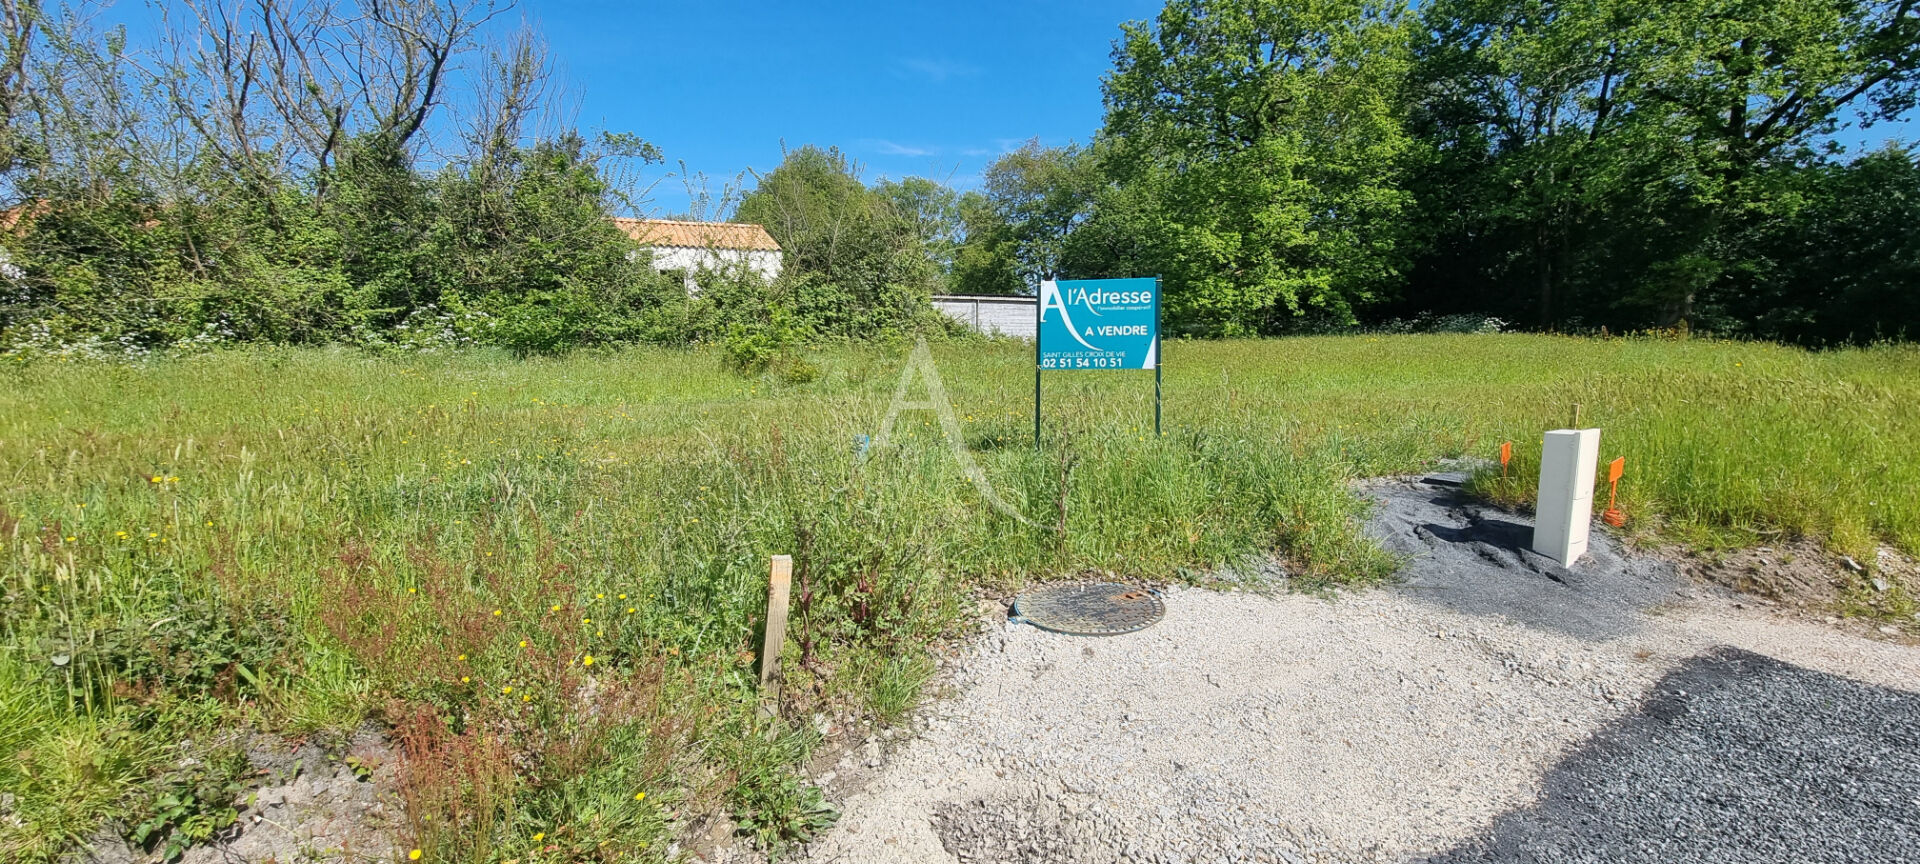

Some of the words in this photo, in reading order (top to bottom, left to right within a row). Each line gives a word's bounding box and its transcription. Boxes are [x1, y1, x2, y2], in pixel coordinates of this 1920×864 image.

[1068, 287, 1152, 316] l'Adresse
[1084, 326, 1094, 337] A
[1097, 325, 1148, 336] VENDRE
[1042, 358, 1056, 368] 02
[1059, 358, 1072, 368] 51
[1076, 358, 1090, 368] 54
[1093, 358, 1107, 368] 10
[1109, 358, 1122, 367] 51
